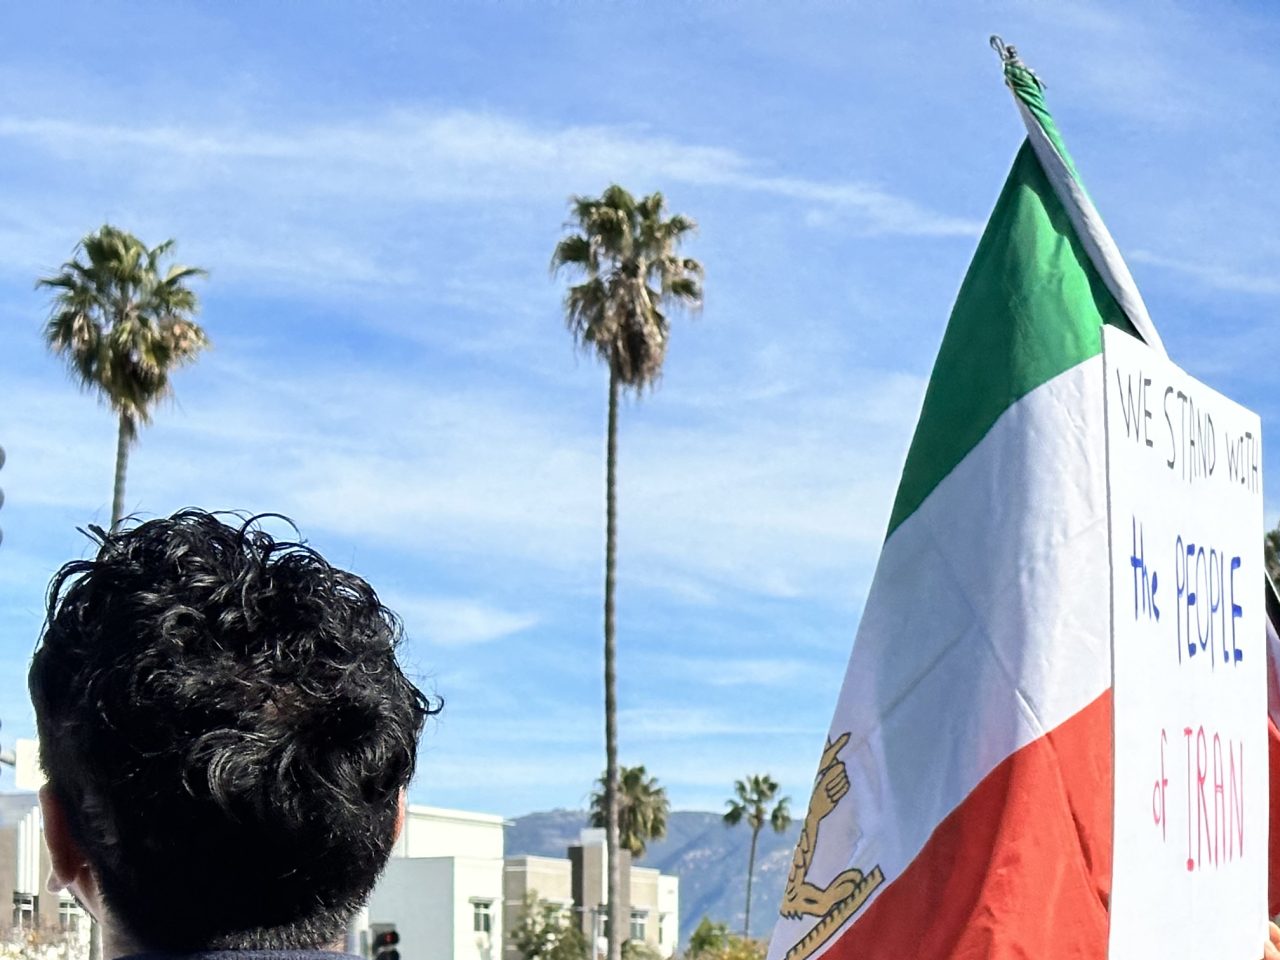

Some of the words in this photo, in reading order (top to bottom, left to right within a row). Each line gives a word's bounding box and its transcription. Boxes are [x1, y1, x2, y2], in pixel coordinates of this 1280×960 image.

[1116, 367, 1154, 449] WE
[1164, 385, 1216, 484] STAND
[1225, 431, 1259, 495] WITH
[1130, 513, 1160, 623] the
[1175, 534, 1244, 673] PEOPLE
[1152, 727, 1169, 843] of
[1183, 724, 1244, 872] IRAN
